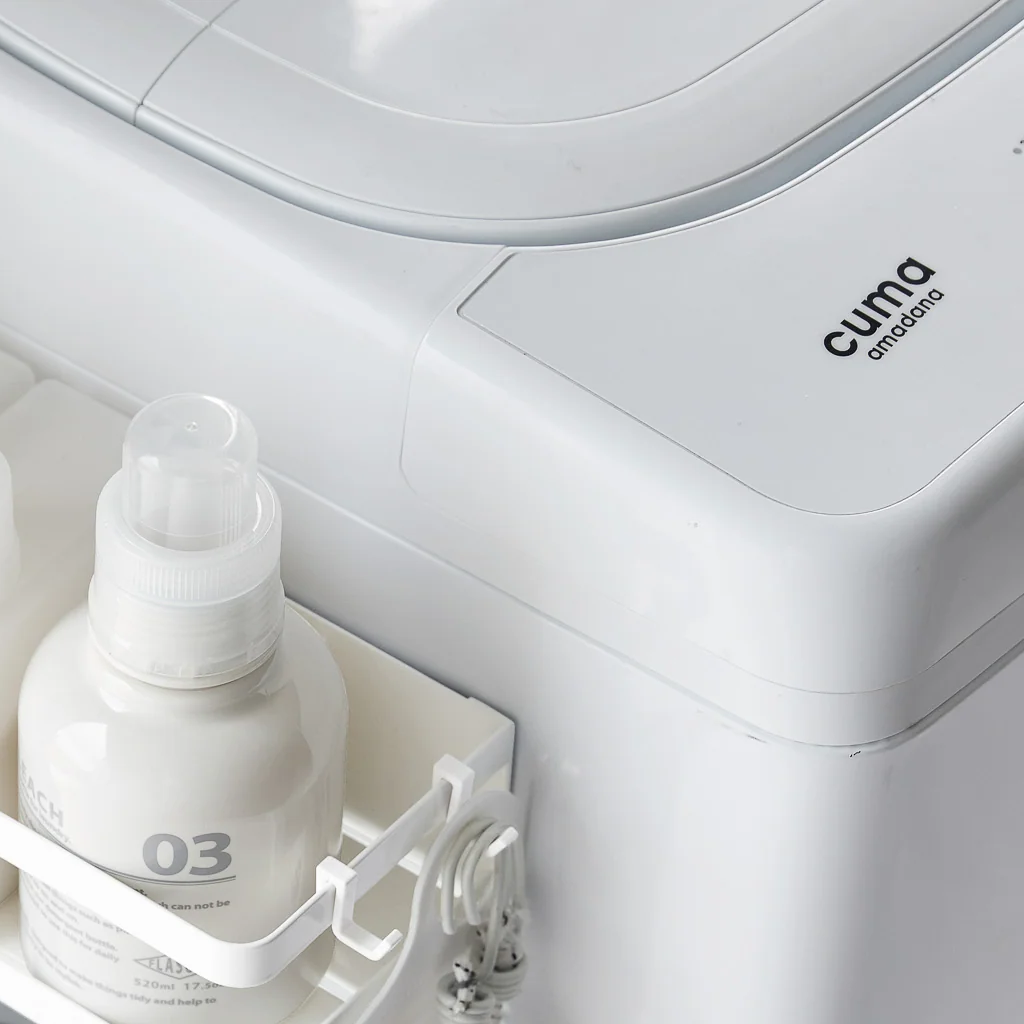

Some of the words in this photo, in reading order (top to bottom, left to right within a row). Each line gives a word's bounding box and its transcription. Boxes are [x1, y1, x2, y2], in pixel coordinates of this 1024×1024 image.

[823, 256, 936, 357] cuma
[867, 288, 945, 361] amadana
[142, 832, 232, 876] 03
[171, 903, 192, 911] can
[194, 901, 215, 911] not
[216, 899, 231, 908] be
[134, 978, 175, 991] 520ml
[153, 997, 175, 1006] and
[177, 998, 203, 1008] help
[205, 997, 217, 1005] to
